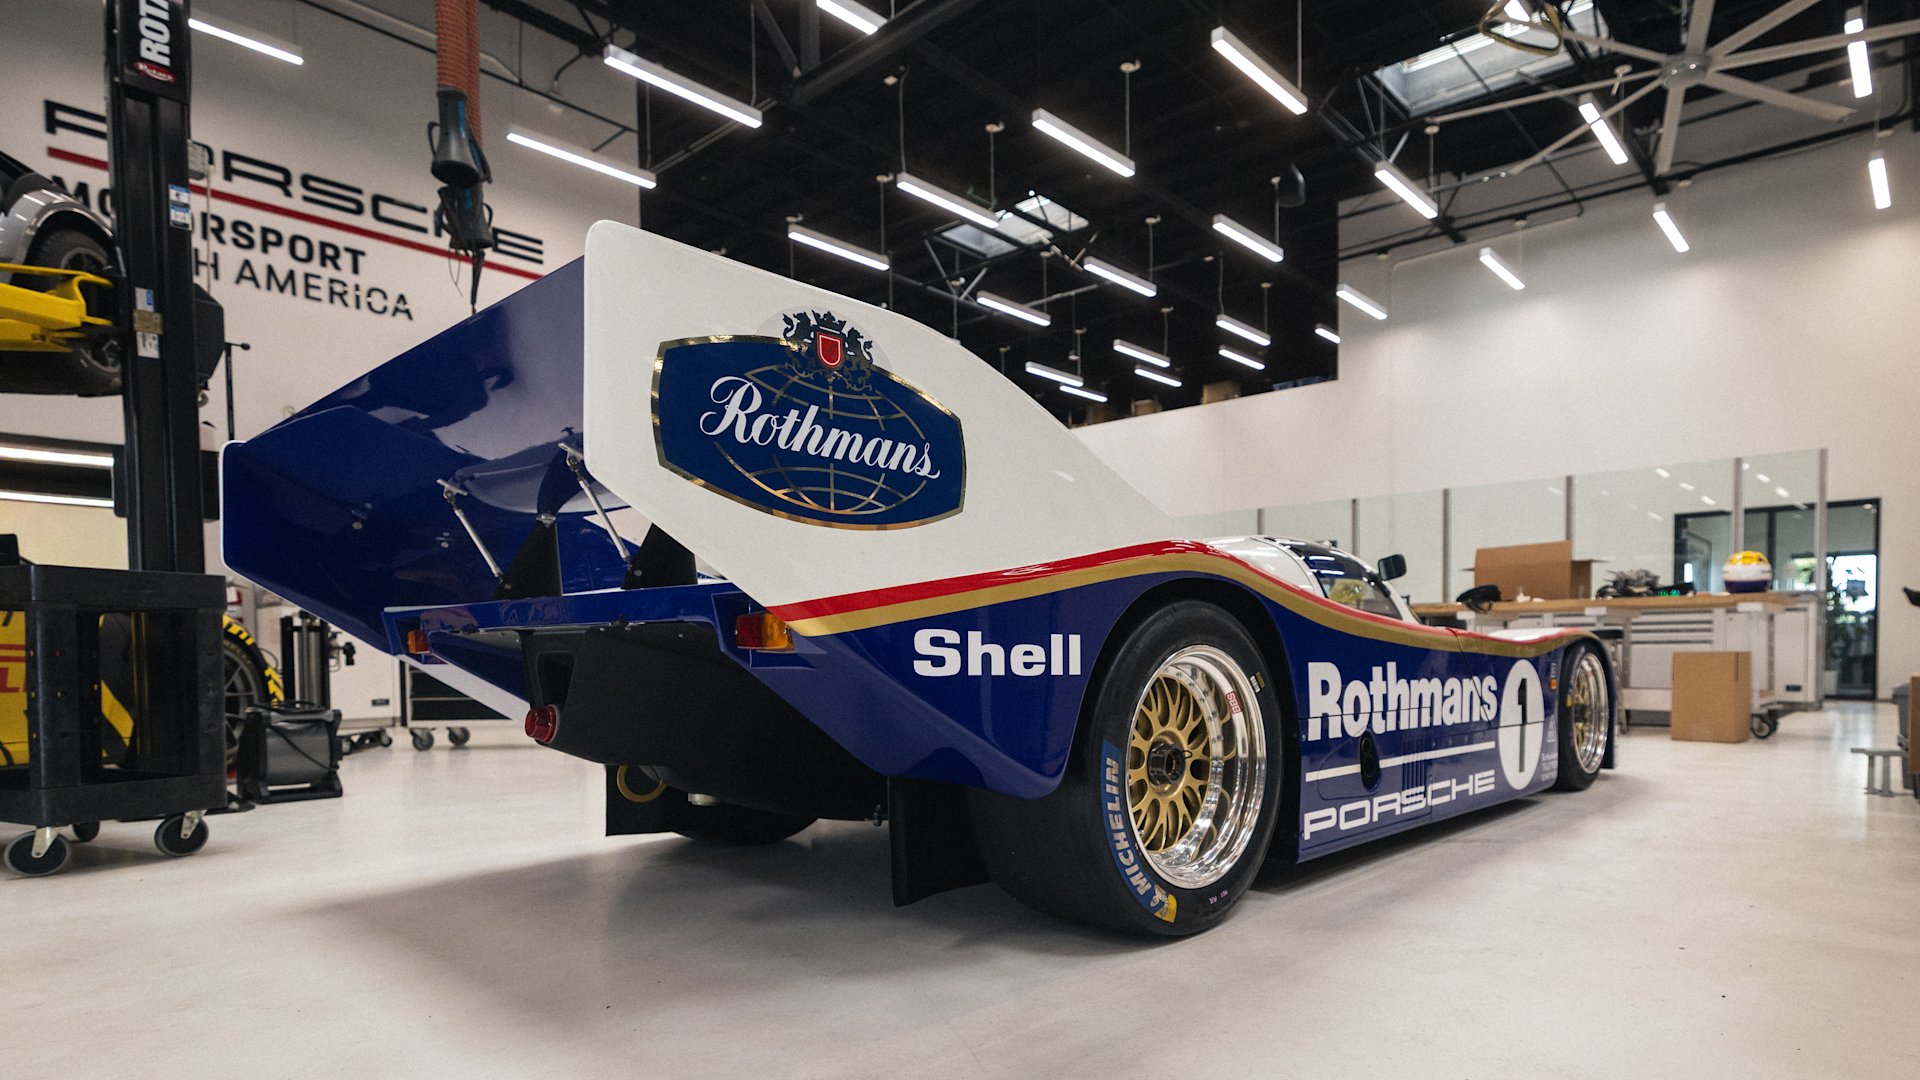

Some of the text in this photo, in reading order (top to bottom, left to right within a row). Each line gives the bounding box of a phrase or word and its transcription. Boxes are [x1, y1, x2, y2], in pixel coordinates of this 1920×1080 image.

[44, 99, 544, 265] PRSCE
[52, 174, 366, 276] MRSPORT
[235, 259, 414, 321] AMERICA
[700, 376, 941, 480] Rothmans
[913, 628, 1082, 677] Shell
[1227, 692, 1242, 713] BBS
[1307, 661, 1498, 742] Rothmans
[1518, 678, 1528, 772] 1
[1105, 757, 1152, 896] MICHELIN
[1303, 770, 1496, 841] PORSCHE
